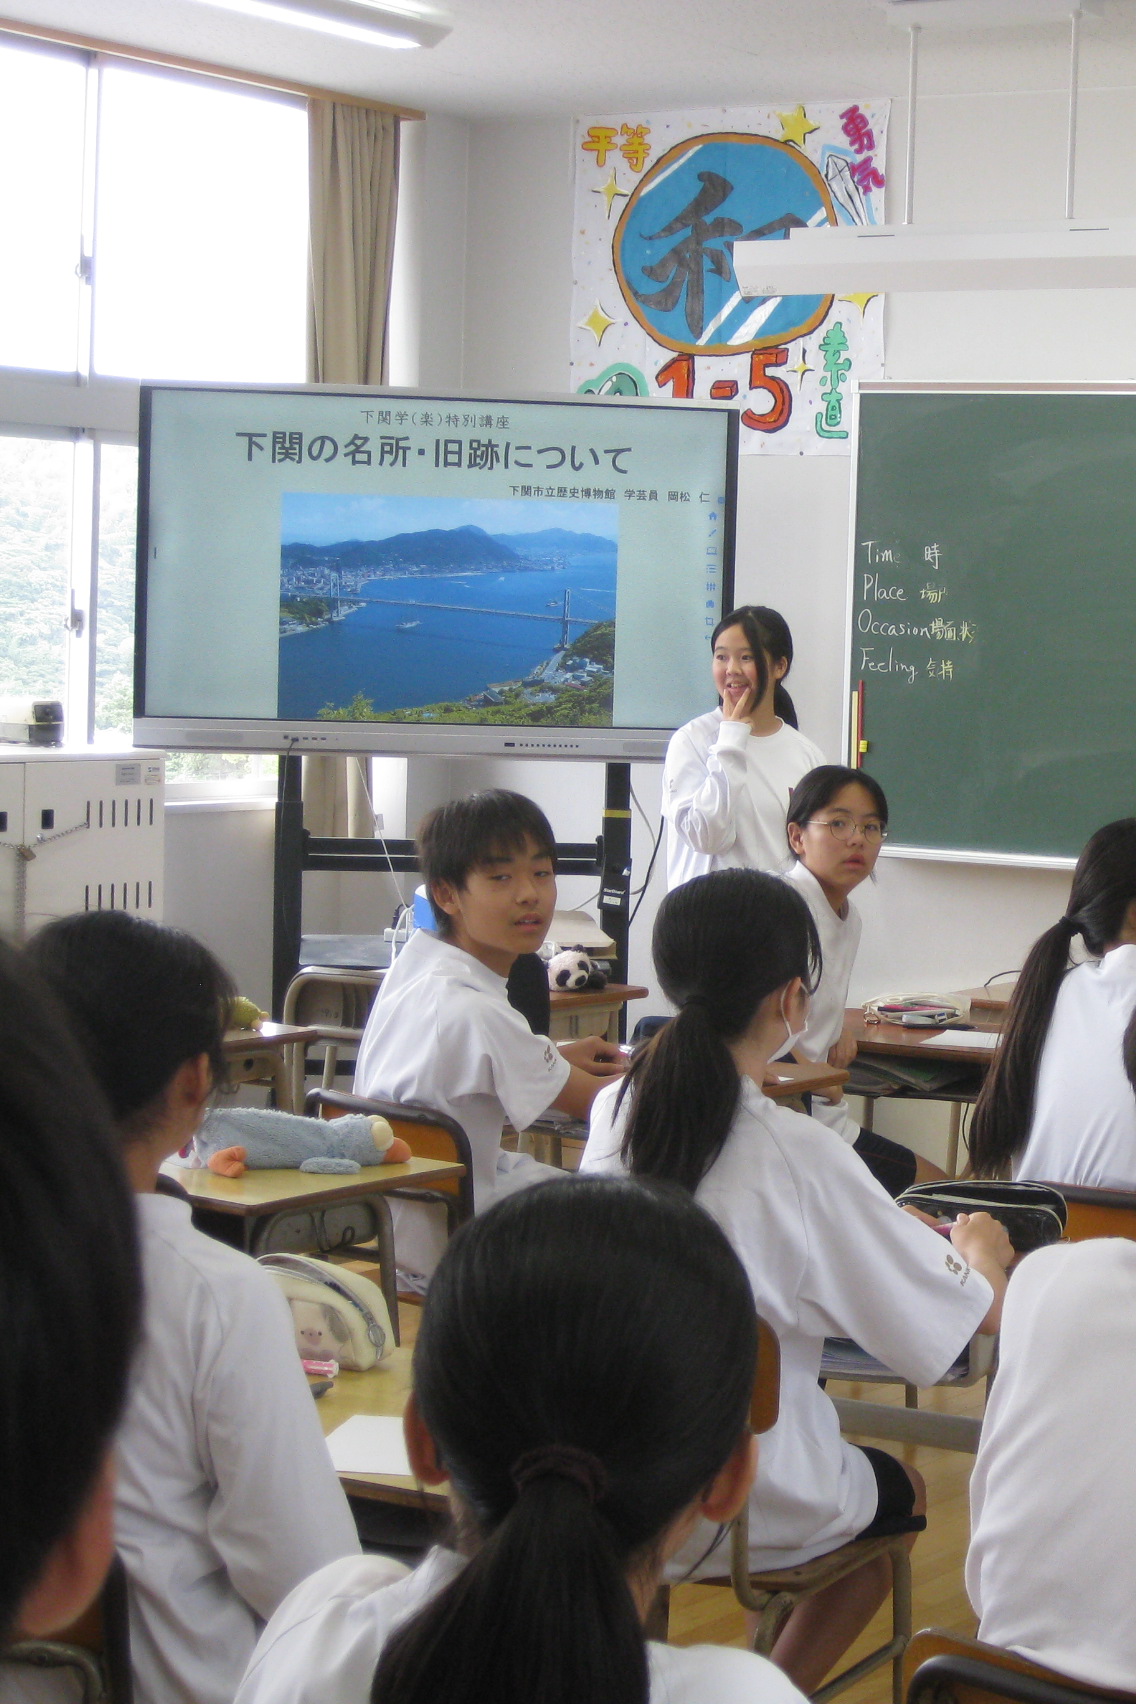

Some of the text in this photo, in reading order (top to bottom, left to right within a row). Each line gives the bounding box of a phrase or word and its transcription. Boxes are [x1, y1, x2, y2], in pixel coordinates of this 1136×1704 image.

[582, 123, 651, 173] 平等
[235, 431, 633, 475] 下関の名所・旧跡について
[509, 485, 616, 500] 下関市立歴史博物館
[624, 489, 658, 501] 学芸員
[667, 490, 691, 502] 岡松
[924, 543, 943, 569] 時
[864, 573, 907, 601] Place
[858, 608, 931, 639] Occasion
[860, 647, 918, 684] Feeling
